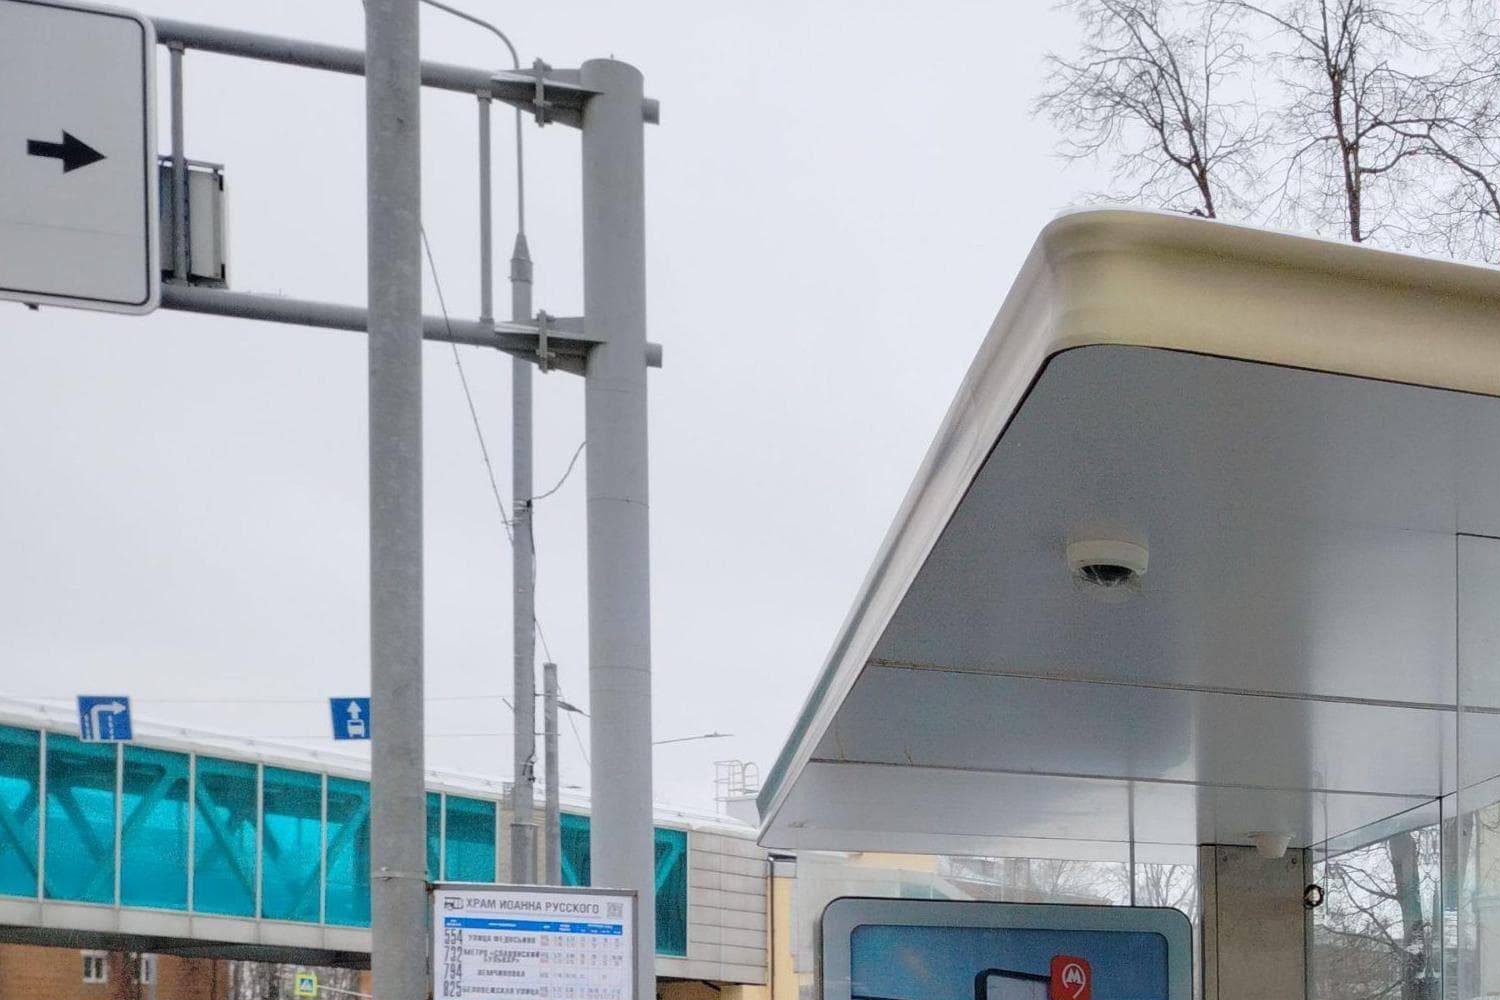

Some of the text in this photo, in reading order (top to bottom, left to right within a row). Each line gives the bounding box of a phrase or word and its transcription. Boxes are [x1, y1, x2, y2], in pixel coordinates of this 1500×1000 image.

[466, 898, 600, 914] ХРАМ ИОАННА РУССКОГО
[444, 928, 463, 945] 554
[443, 945, 463, 963] 732
[443, 962, 462, 979] 794
[443, 980, 462, 997] 825
